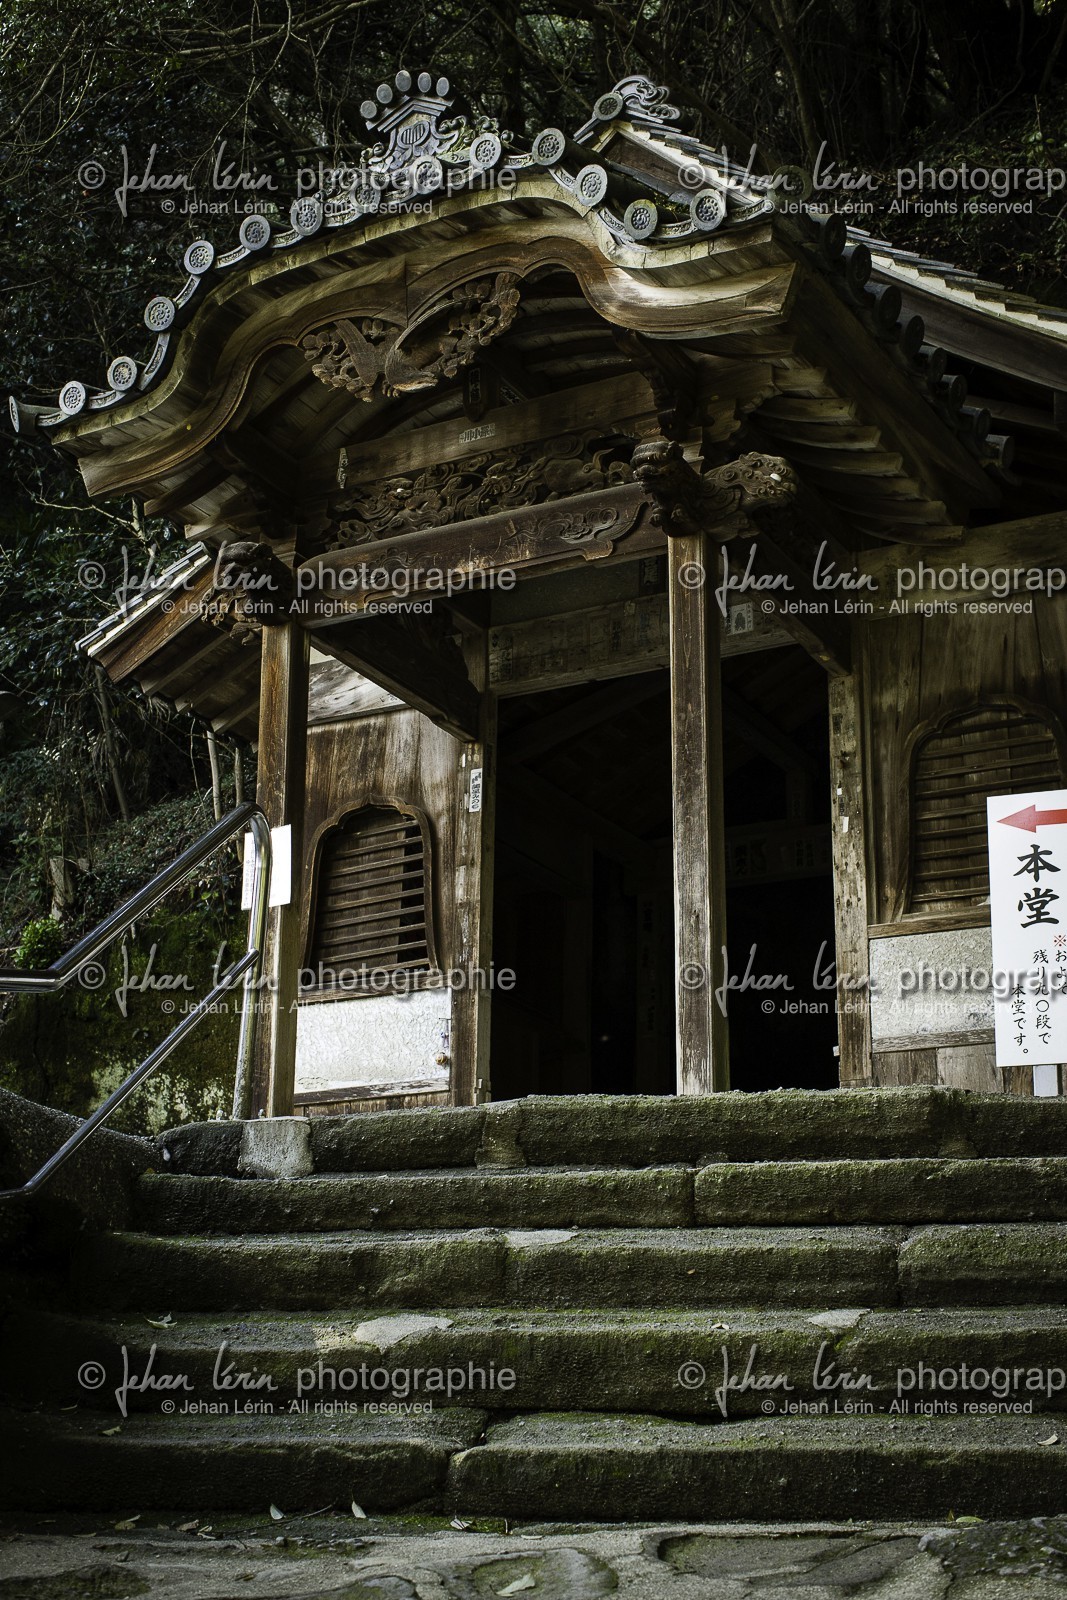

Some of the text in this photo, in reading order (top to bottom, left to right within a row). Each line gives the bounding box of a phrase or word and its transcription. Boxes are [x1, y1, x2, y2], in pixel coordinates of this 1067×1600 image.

[1013, 844, 1061, 929] 本堂
[1011, 984, 1029, 1054] 本堂です。
